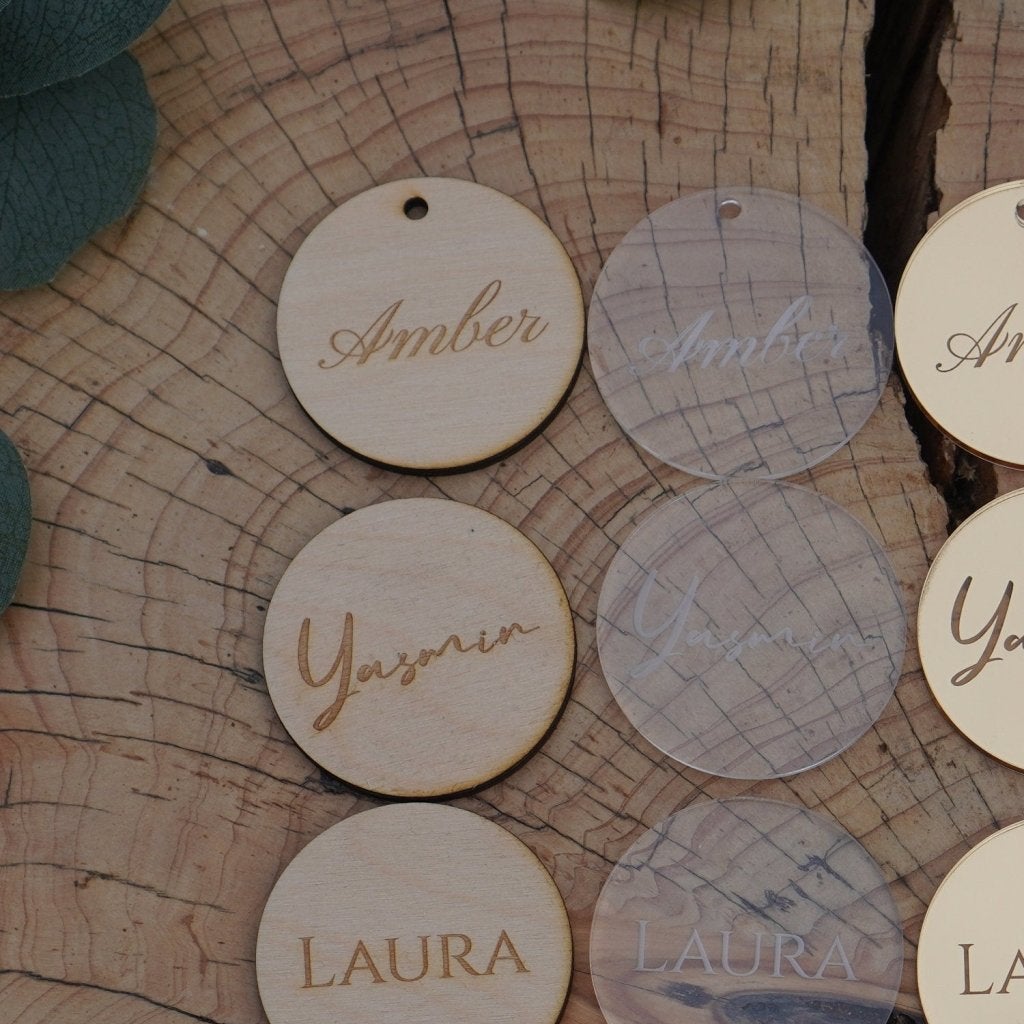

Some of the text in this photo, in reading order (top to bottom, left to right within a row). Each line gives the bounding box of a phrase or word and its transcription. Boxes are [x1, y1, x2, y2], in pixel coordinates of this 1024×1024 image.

[318, 280, 549, 370] Amber
[627, 295, 851, 374] Amber
[297, 612, 540, 732] Yasmin
[631, 568, 878, 679] Yasmin
